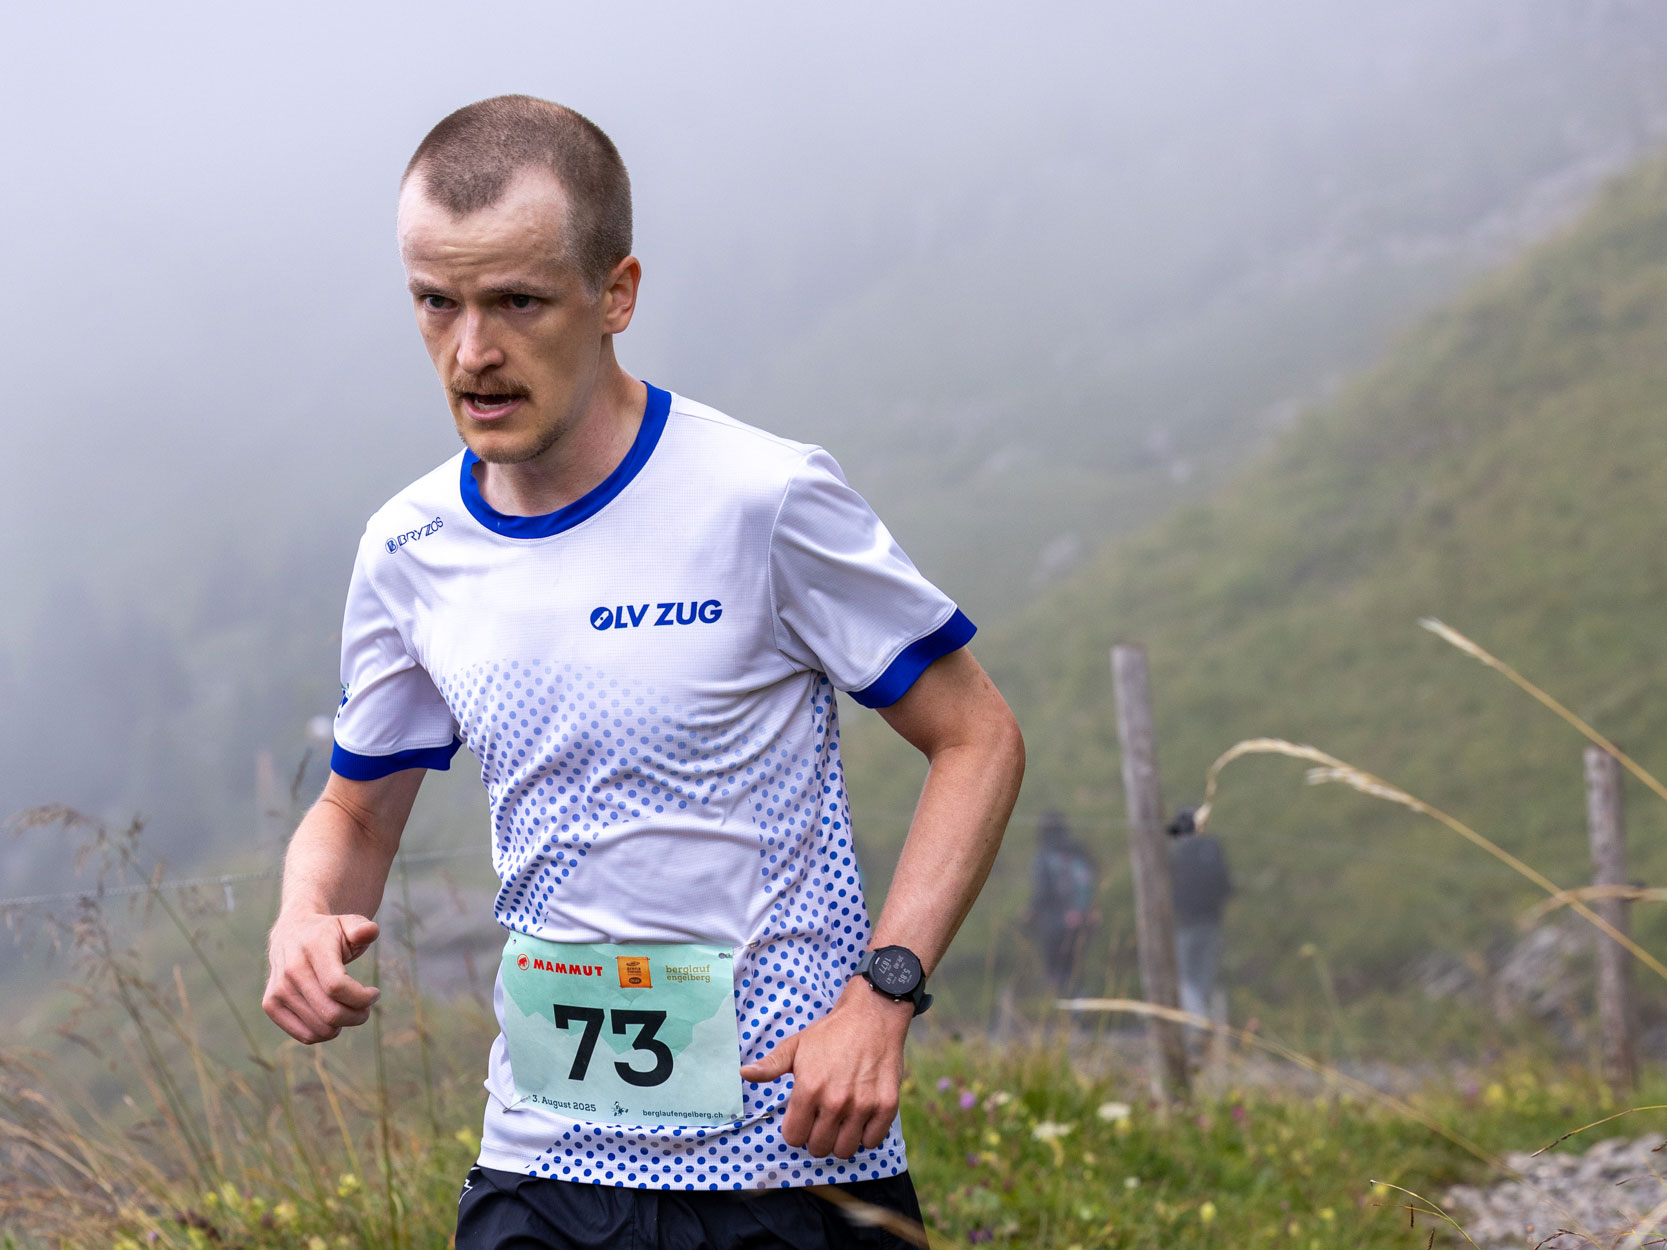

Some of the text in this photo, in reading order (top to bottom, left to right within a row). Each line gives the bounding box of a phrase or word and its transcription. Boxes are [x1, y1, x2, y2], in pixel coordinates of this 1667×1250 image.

[397, 516, 444, 547] BRYZOS
[653, 599, 723, 627] ZUG
[533, 958, 603, 977] MAMMUT
[665, 964, 711, 975] berglauf
[666, 974, 711, 984] engelberg
[553, 1003, 674, 1087] 73
[532, 1094, 597, 1112] 3. August 2025
[642, 1109, 724, 1120] berglaufengelberg.ch
